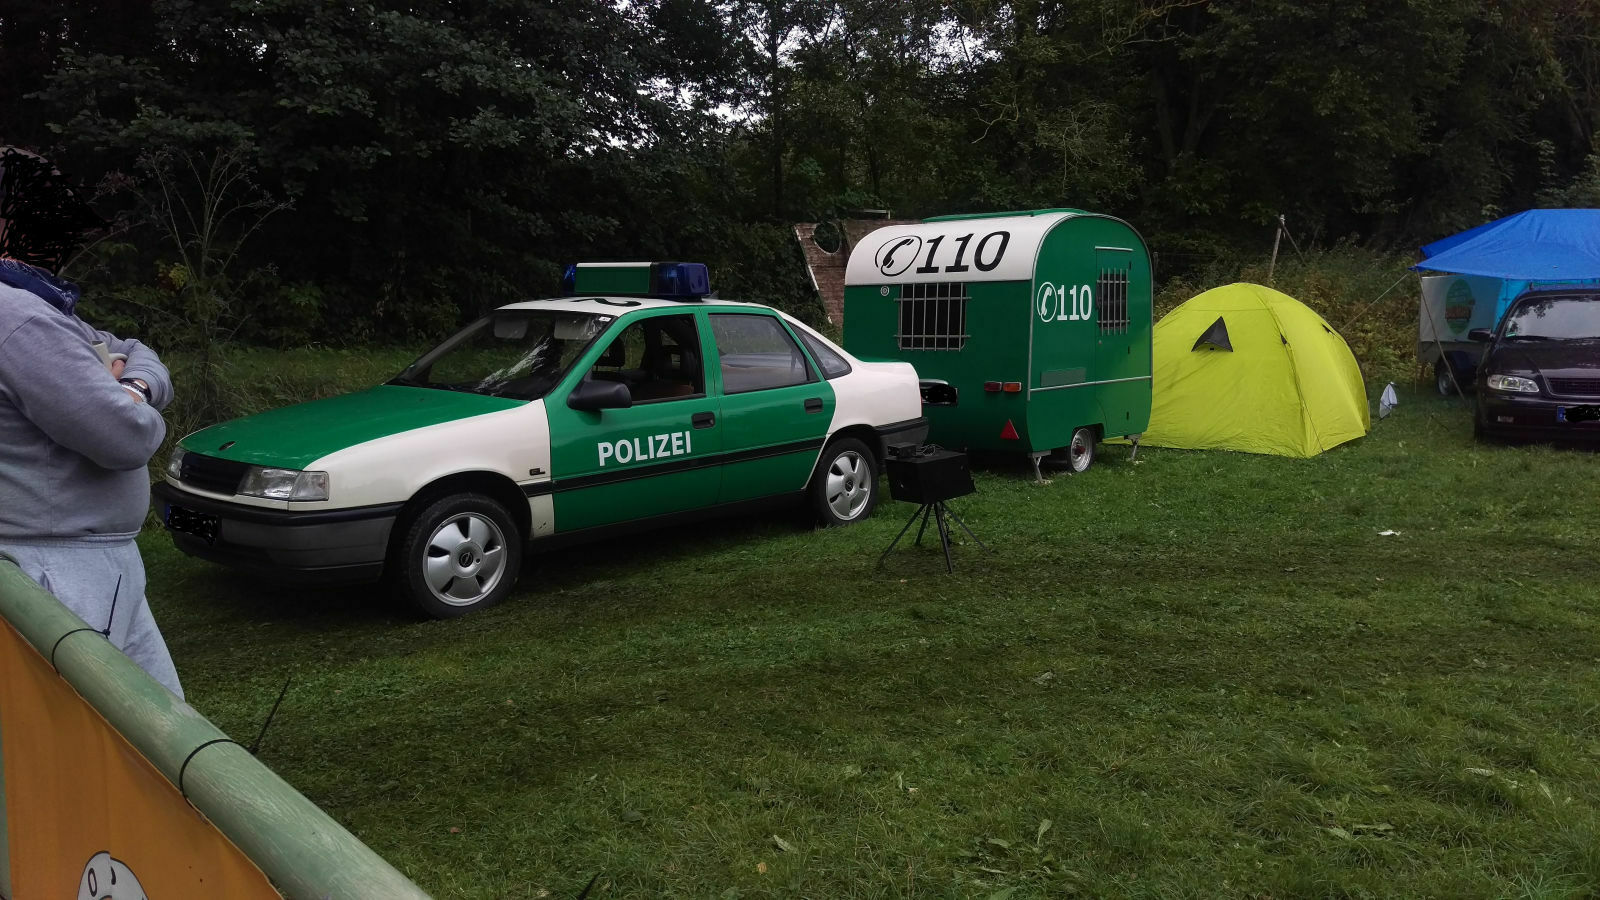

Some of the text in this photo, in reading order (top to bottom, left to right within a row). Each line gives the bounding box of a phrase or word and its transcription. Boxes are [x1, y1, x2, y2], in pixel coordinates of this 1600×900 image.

[916, 230, 1011, 274] 110
[1057, 284, 1092, 321] 110
[597, 430, 692, 467] POLIZEI
